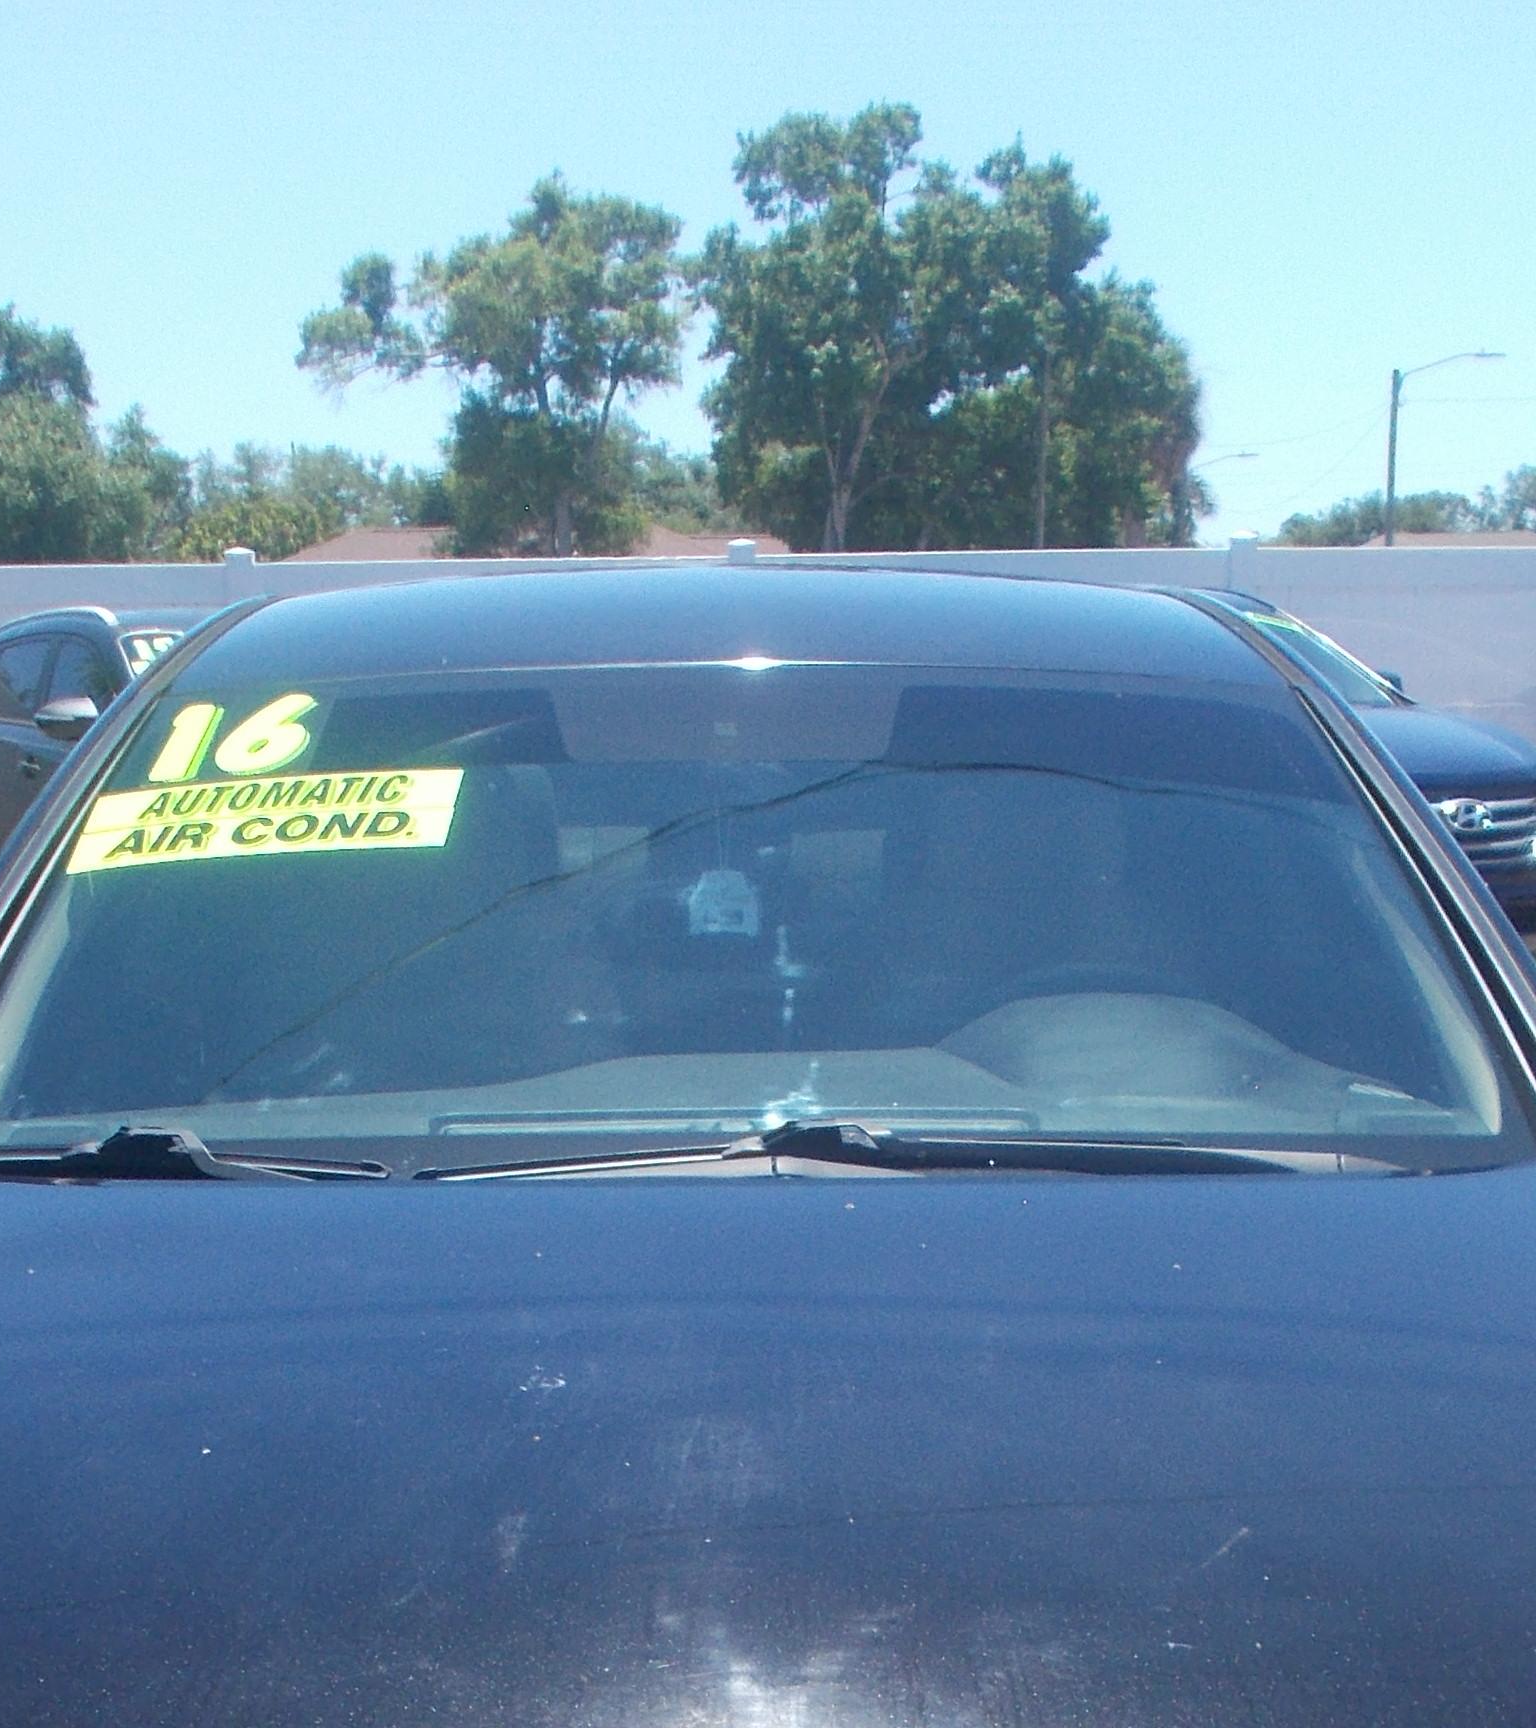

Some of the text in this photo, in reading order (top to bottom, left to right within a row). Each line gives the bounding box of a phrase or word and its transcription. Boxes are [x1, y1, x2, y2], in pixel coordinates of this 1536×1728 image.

[147, 693, 319, 783] 16
[137, 774, 412, 820] AUTOMATIC
[103, 810, 416, 861] AIR COND.
